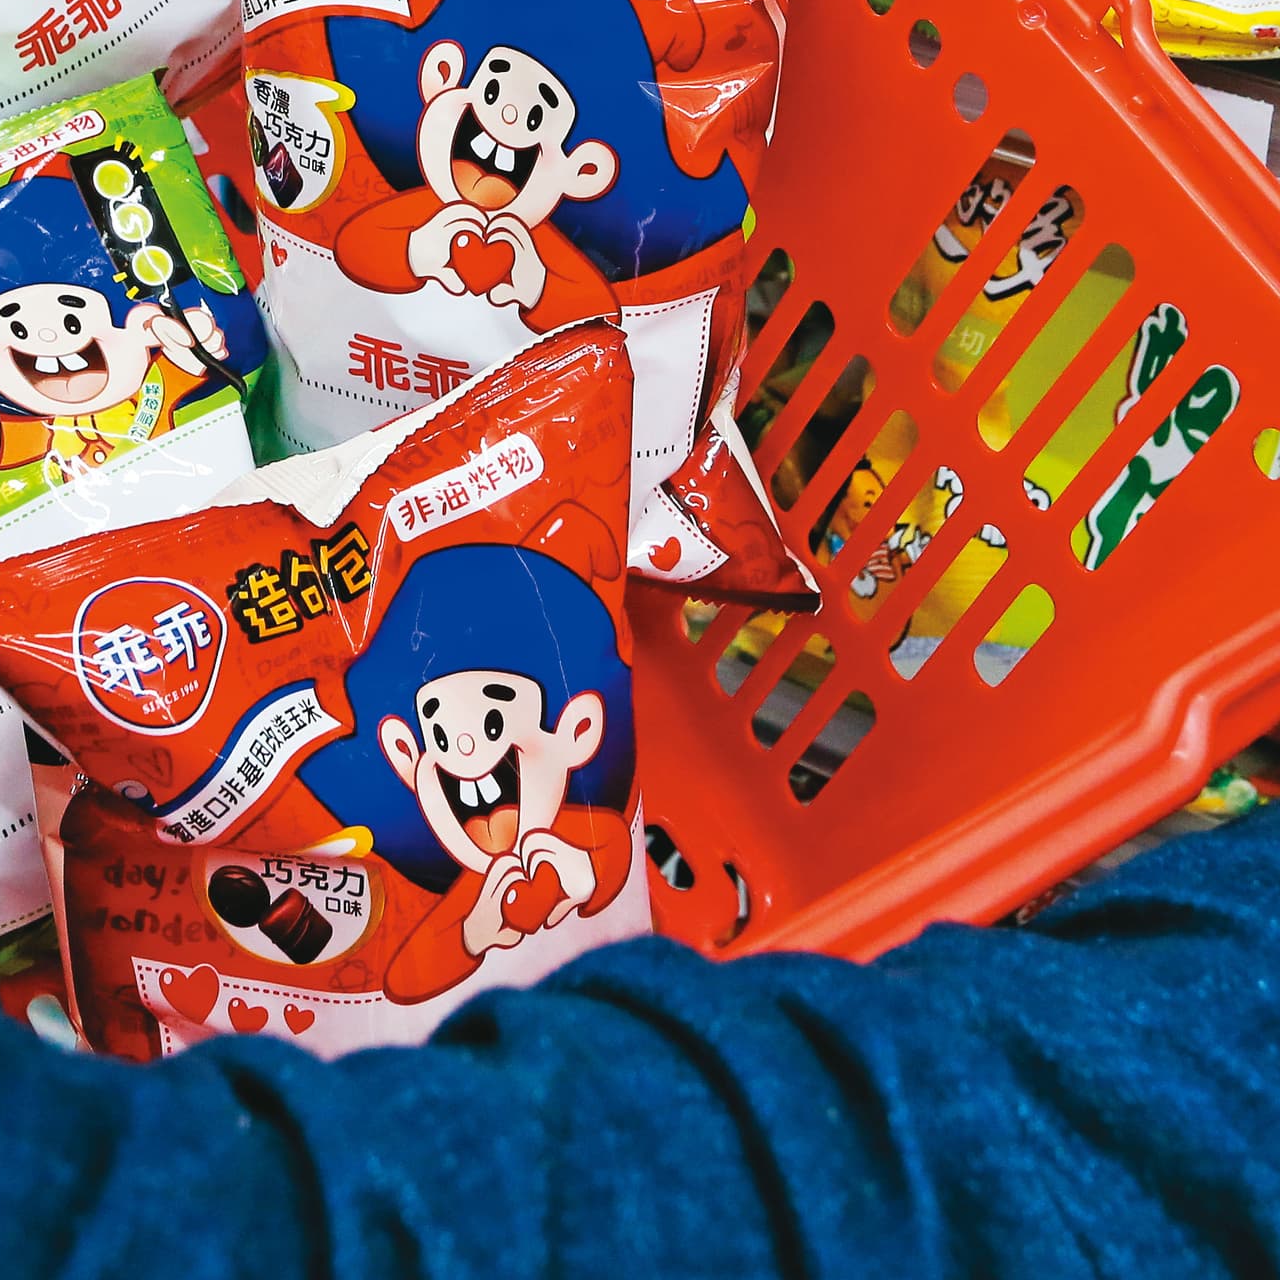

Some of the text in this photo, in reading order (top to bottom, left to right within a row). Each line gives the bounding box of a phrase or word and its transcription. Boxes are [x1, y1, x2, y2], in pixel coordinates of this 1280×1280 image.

[253, 78, 291, 119] 香濃
[263, 111, 331, 158] 巧克力
[299, 155, 326, 176] 口味
[348, 333, 474, 401] 乖乖
[398, 445, 534, 531] 非油炸物
[239, 528, 372, 639] 造句包
[93, 601, 213, 697] 乖乖
[142, 679, 201, 716] SINCE 1968
[260, 857, 365, 898] 巧克力
[325, 896, 363, 918] 口味
